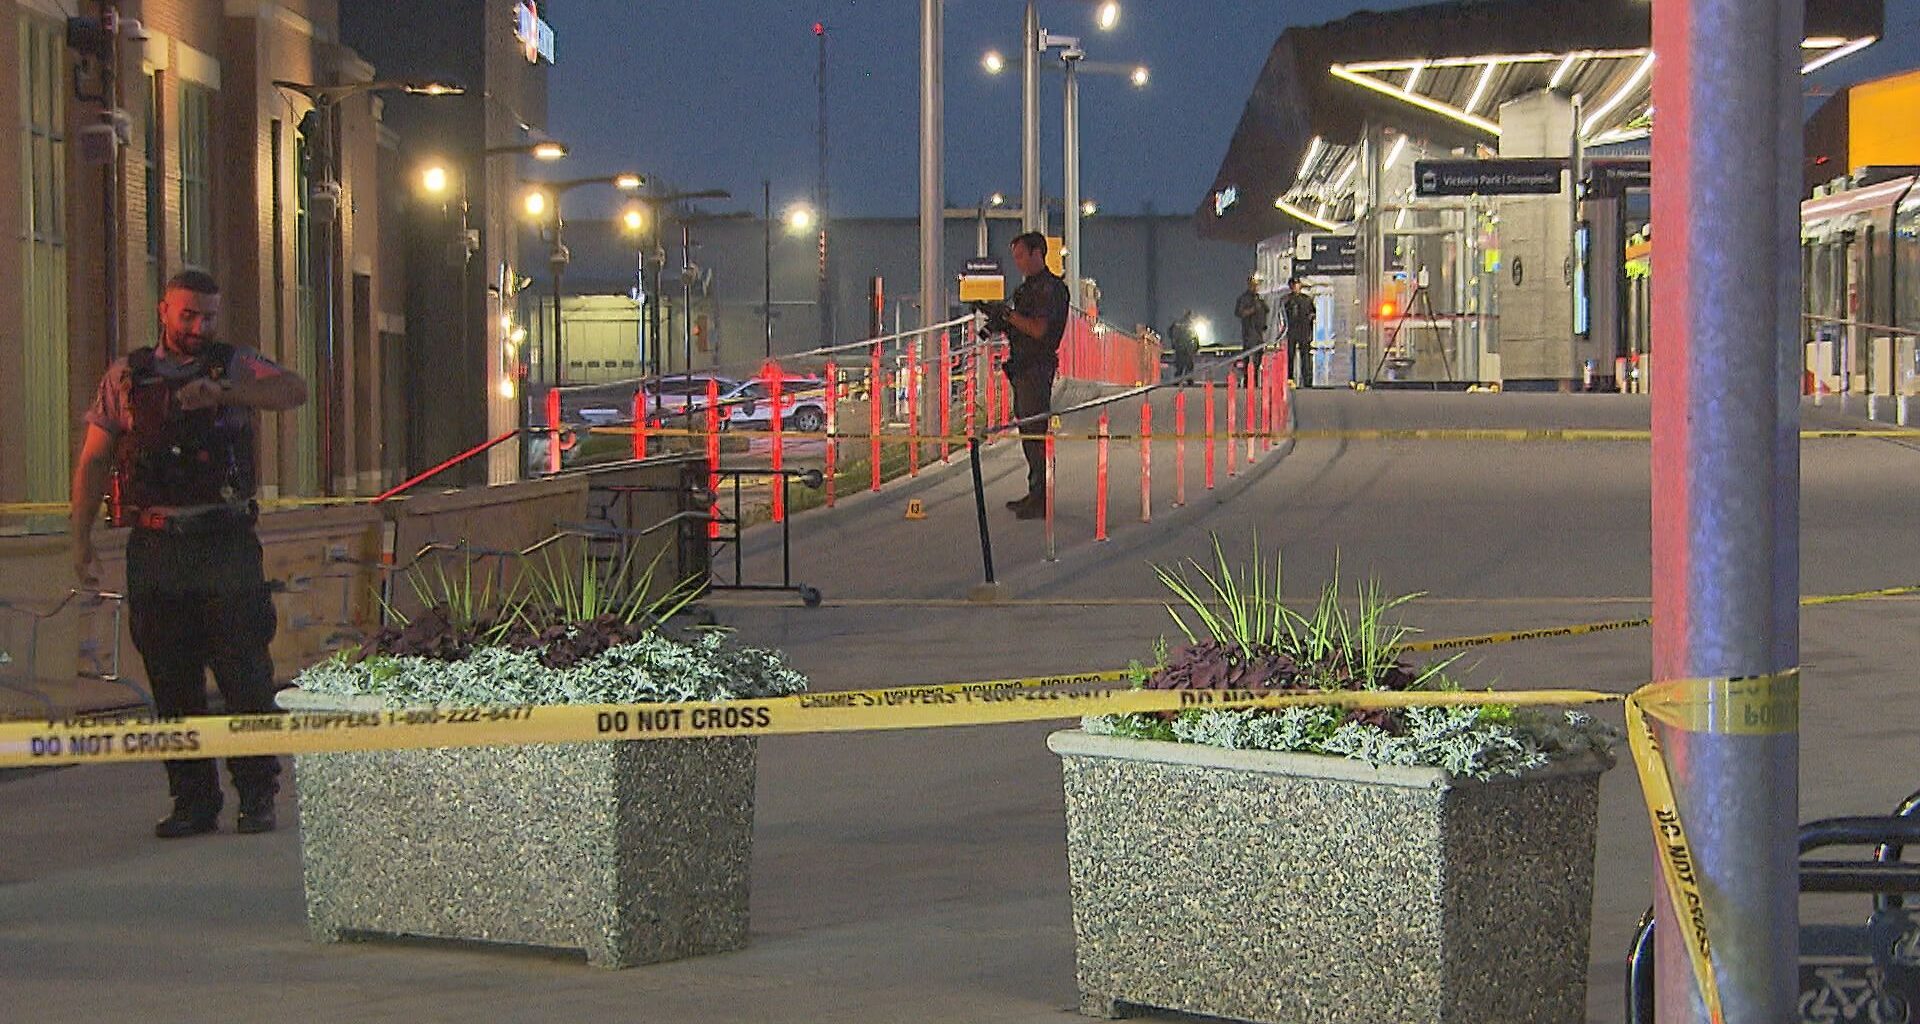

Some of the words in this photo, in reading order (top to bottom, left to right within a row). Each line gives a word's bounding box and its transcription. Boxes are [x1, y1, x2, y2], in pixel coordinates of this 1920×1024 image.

[1442, 174, 1478, 186] Victoria
[1479, 174, 1501, 187] Park
[1507, 173, 1554, 187] Stampede
[228, 714, 282, 732] CRIME
[290, 710, 381, 732] STOPPERS
[598, 711, 629, 733] DO
[638, 709, 684, 732] NOT
[691, 707, 770, 730] CROSS
[32, 736, 61, 756] DO
[69, 734, 115, 755] NOT
[123, 730, 201, 754] CROSS
[1655, 808, 1682, 838] DO
[1668, 845, 1697, 885] NOT
